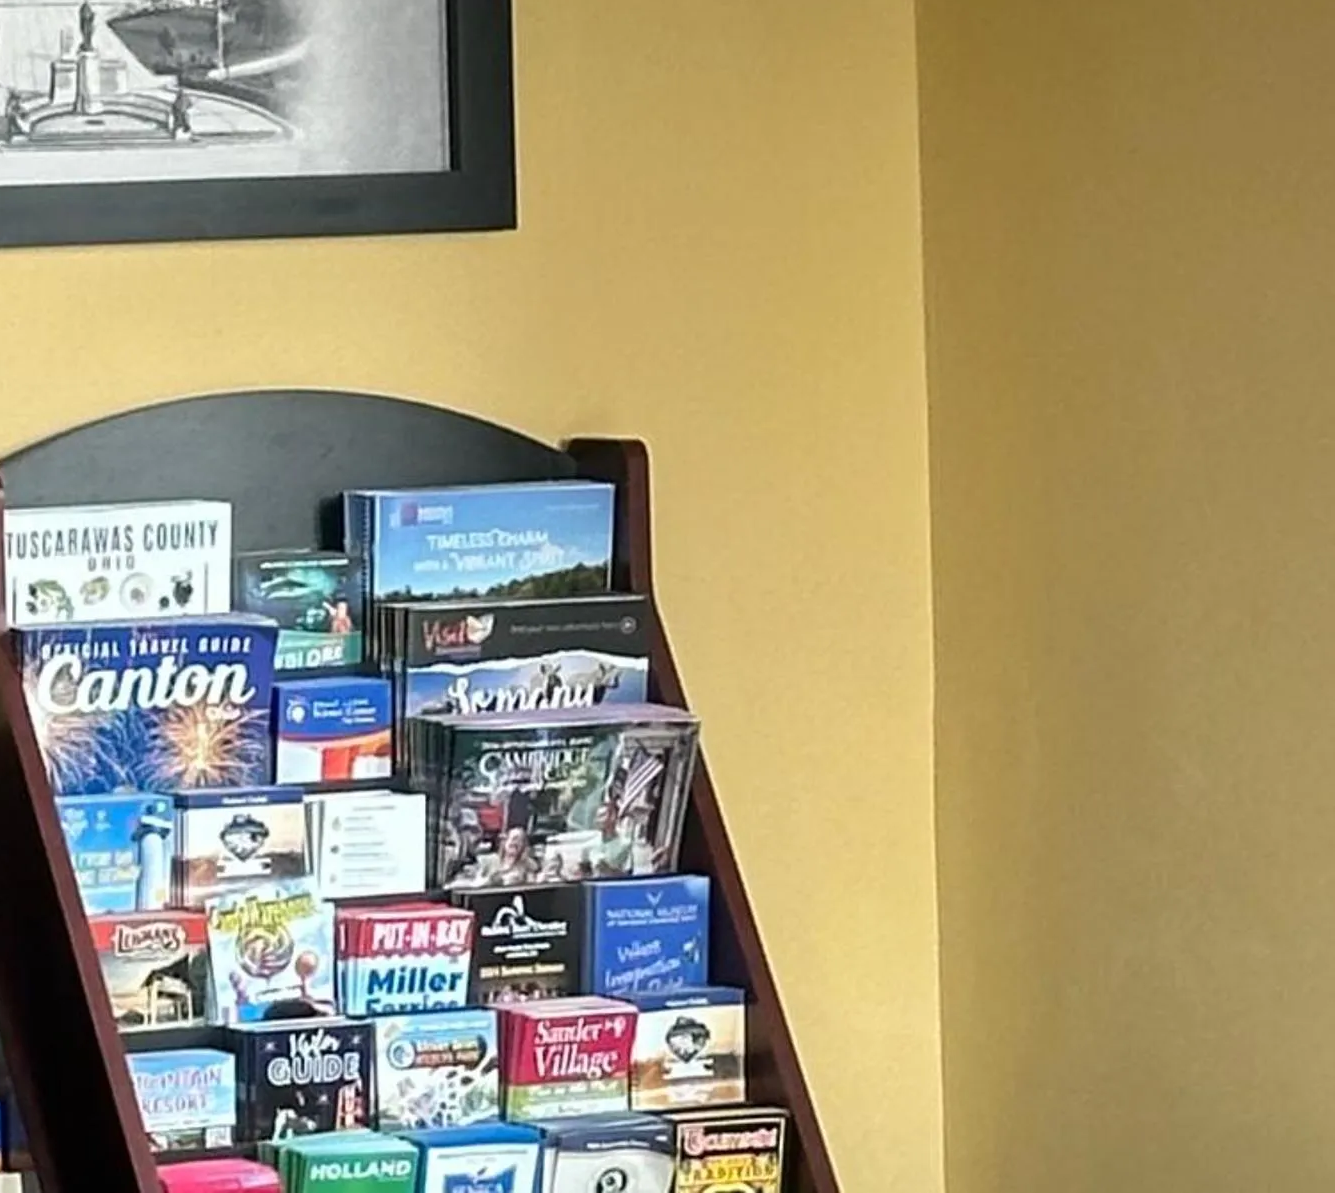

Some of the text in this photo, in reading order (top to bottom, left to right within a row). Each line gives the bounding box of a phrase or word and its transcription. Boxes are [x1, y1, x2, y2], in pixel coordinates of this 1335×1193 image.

[6, 520, 218, 560] TUSCARAWAS COUNTY
[87, 555, 136, 571] OHIO
[41, 637, 252, 660] OFFICIAL TRAVEL GUIDE
[37, 657, 256, 713] Canton
[367, 966, 464, 995] Miller
[267, 1052, 362, 1086] GUIDE
[534, 1046, 618, 1080] Village
[310, 1159, 413, 1181] HOLLAND
